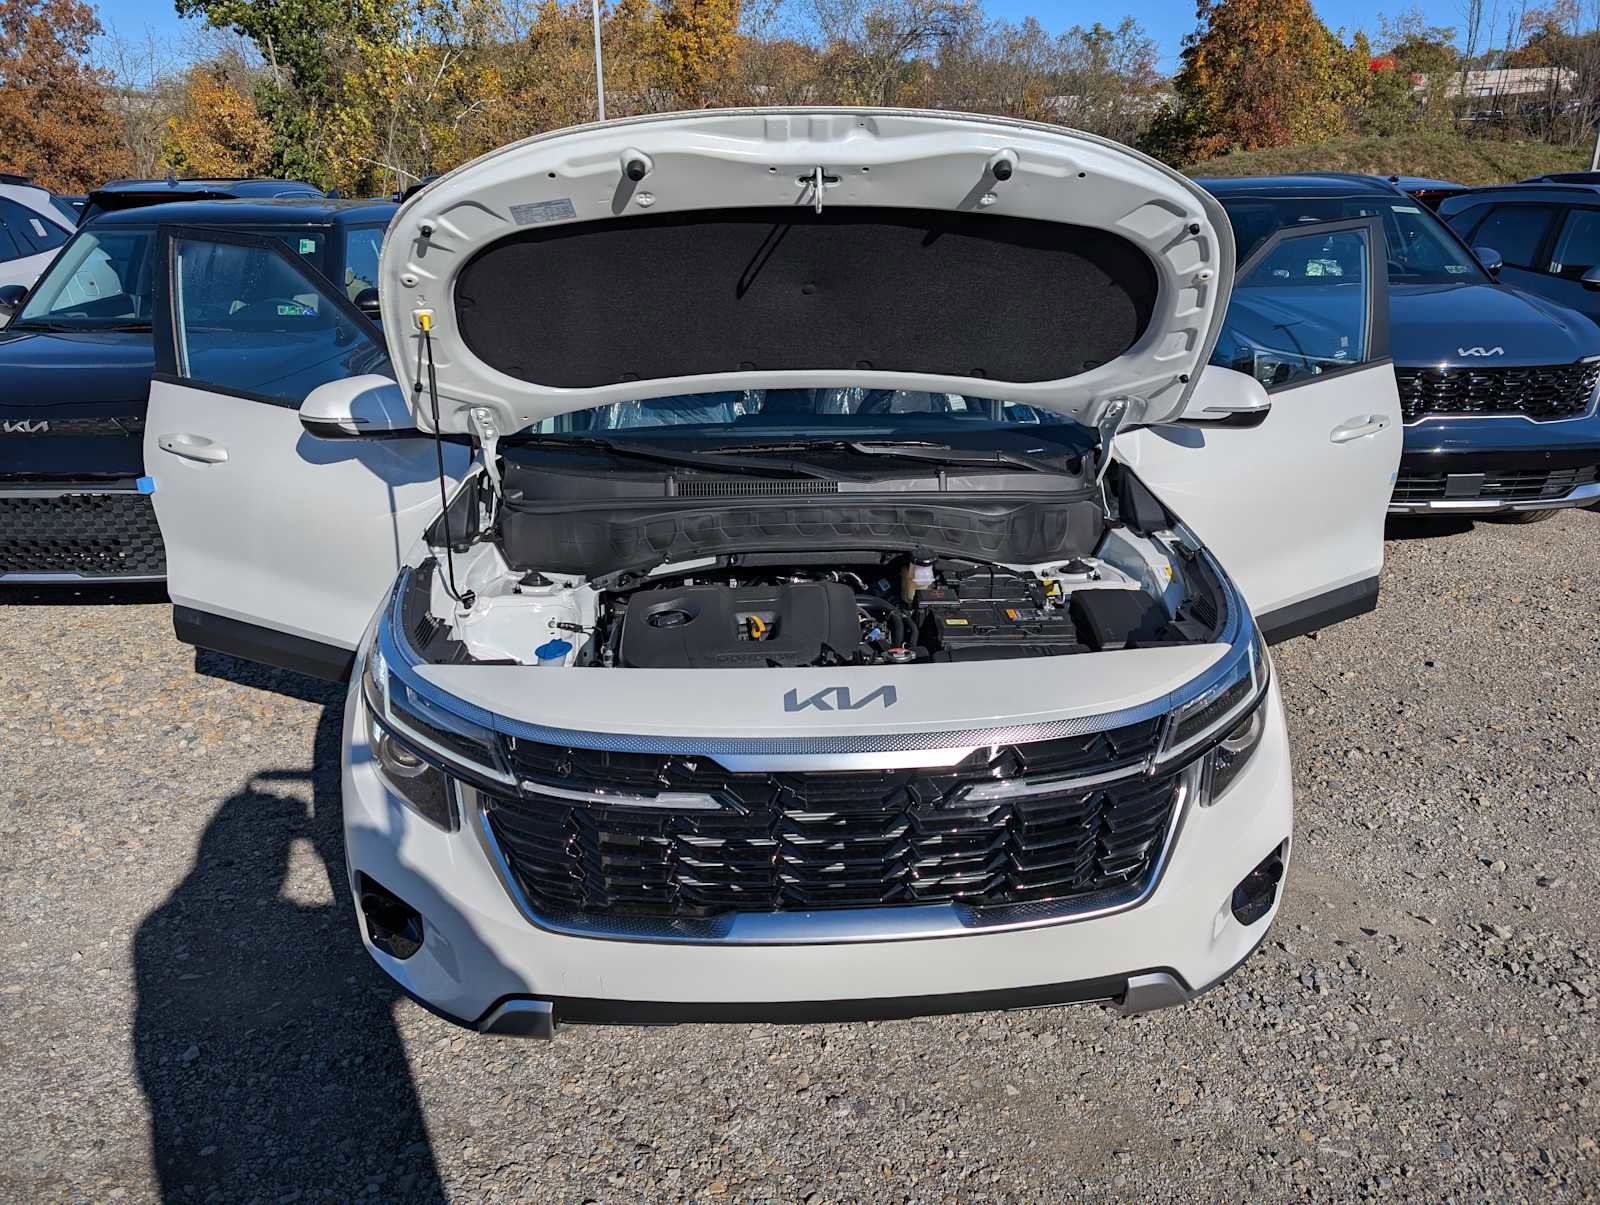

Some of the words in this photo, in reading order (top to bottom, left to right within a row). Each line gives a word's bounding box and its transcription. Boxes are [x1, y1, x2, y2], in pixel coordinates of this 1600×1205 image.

[1458, 347, 1504, 356] KIA
[3, 419, 48, 432] KIA
[784, 685, 897, 712] KIA
